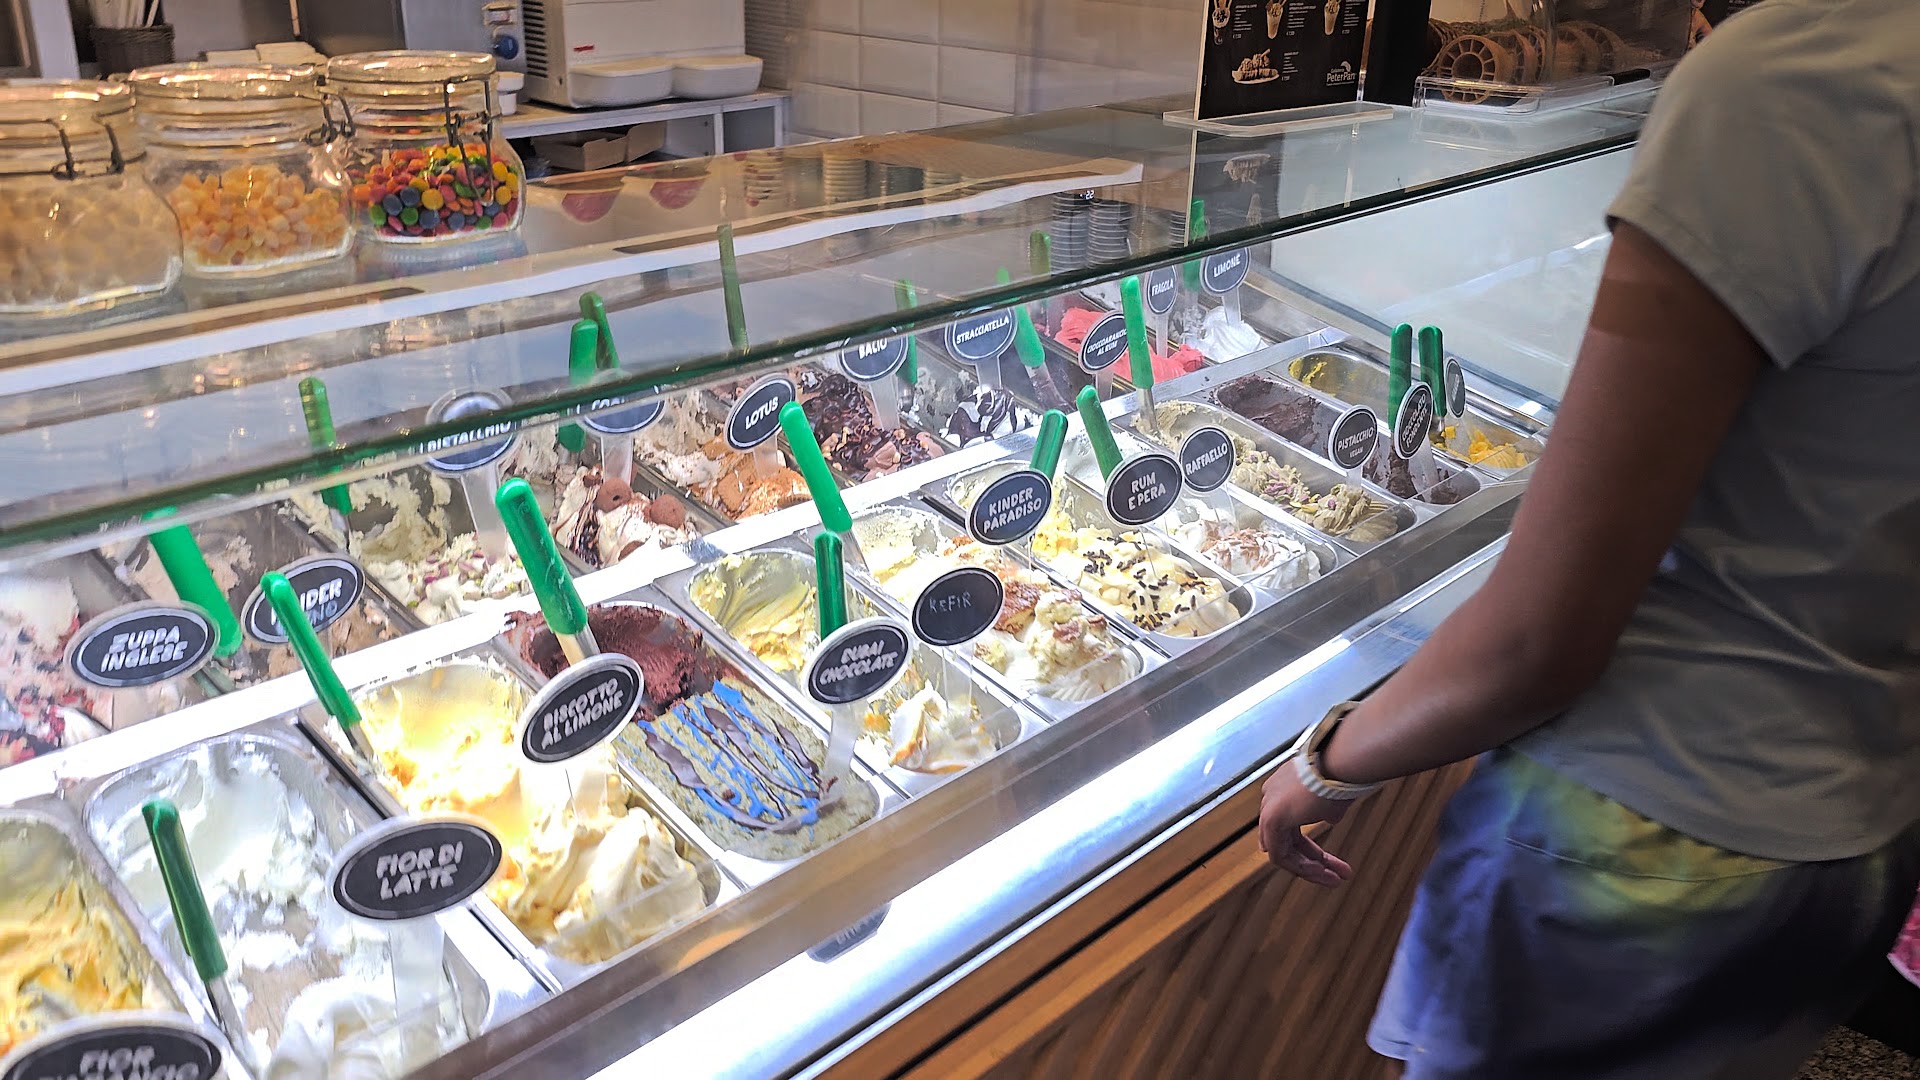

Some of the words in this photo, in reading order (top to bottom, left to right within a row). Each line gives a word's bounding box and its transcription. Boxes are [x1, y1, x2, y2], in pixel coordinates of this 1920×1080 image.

[1213, 253, 1241, 278] LIMONE
[1151, 278, 1174, 297] FRAGOLA
[956, 314, 1010, 344] STRACCIATELLA
[858, 337, 887, 360] BACIO
[745, 396, 779, 430] LOTUS
[1337, 427, 1374, 452] PISTACCHIO
[1349, 446, 1364, 458] VEGAN
[1185, 442, 1228, 475] RAFFAELLO
[1128, 495, 1136, 511] E
[1137, 482, 1167, 507] PERA
[1131, 471, 1156, 494] RUM
[983, 497, 1042, 534] PARADISO
[989, 487, 1034, 517] KINDER
[109, 625, 181, 653] ZUPPA
[840, 639, 885, 665] DUBAI
[101, 640, 188, 673] INGLESE
[820, 651, 899, 685] CHOCOLATE
[541, 725, 562, 750] AL
[564, 690, 624, 738] LIMONE
[543, 678, 618, 732] BISCOTTO
[376, 847, 435, 879] FIOR
[438, 840, 464, 867] DI
[380, 863, 458, 900] LATTE
[80, 1045, 155, 1078] FIOR
